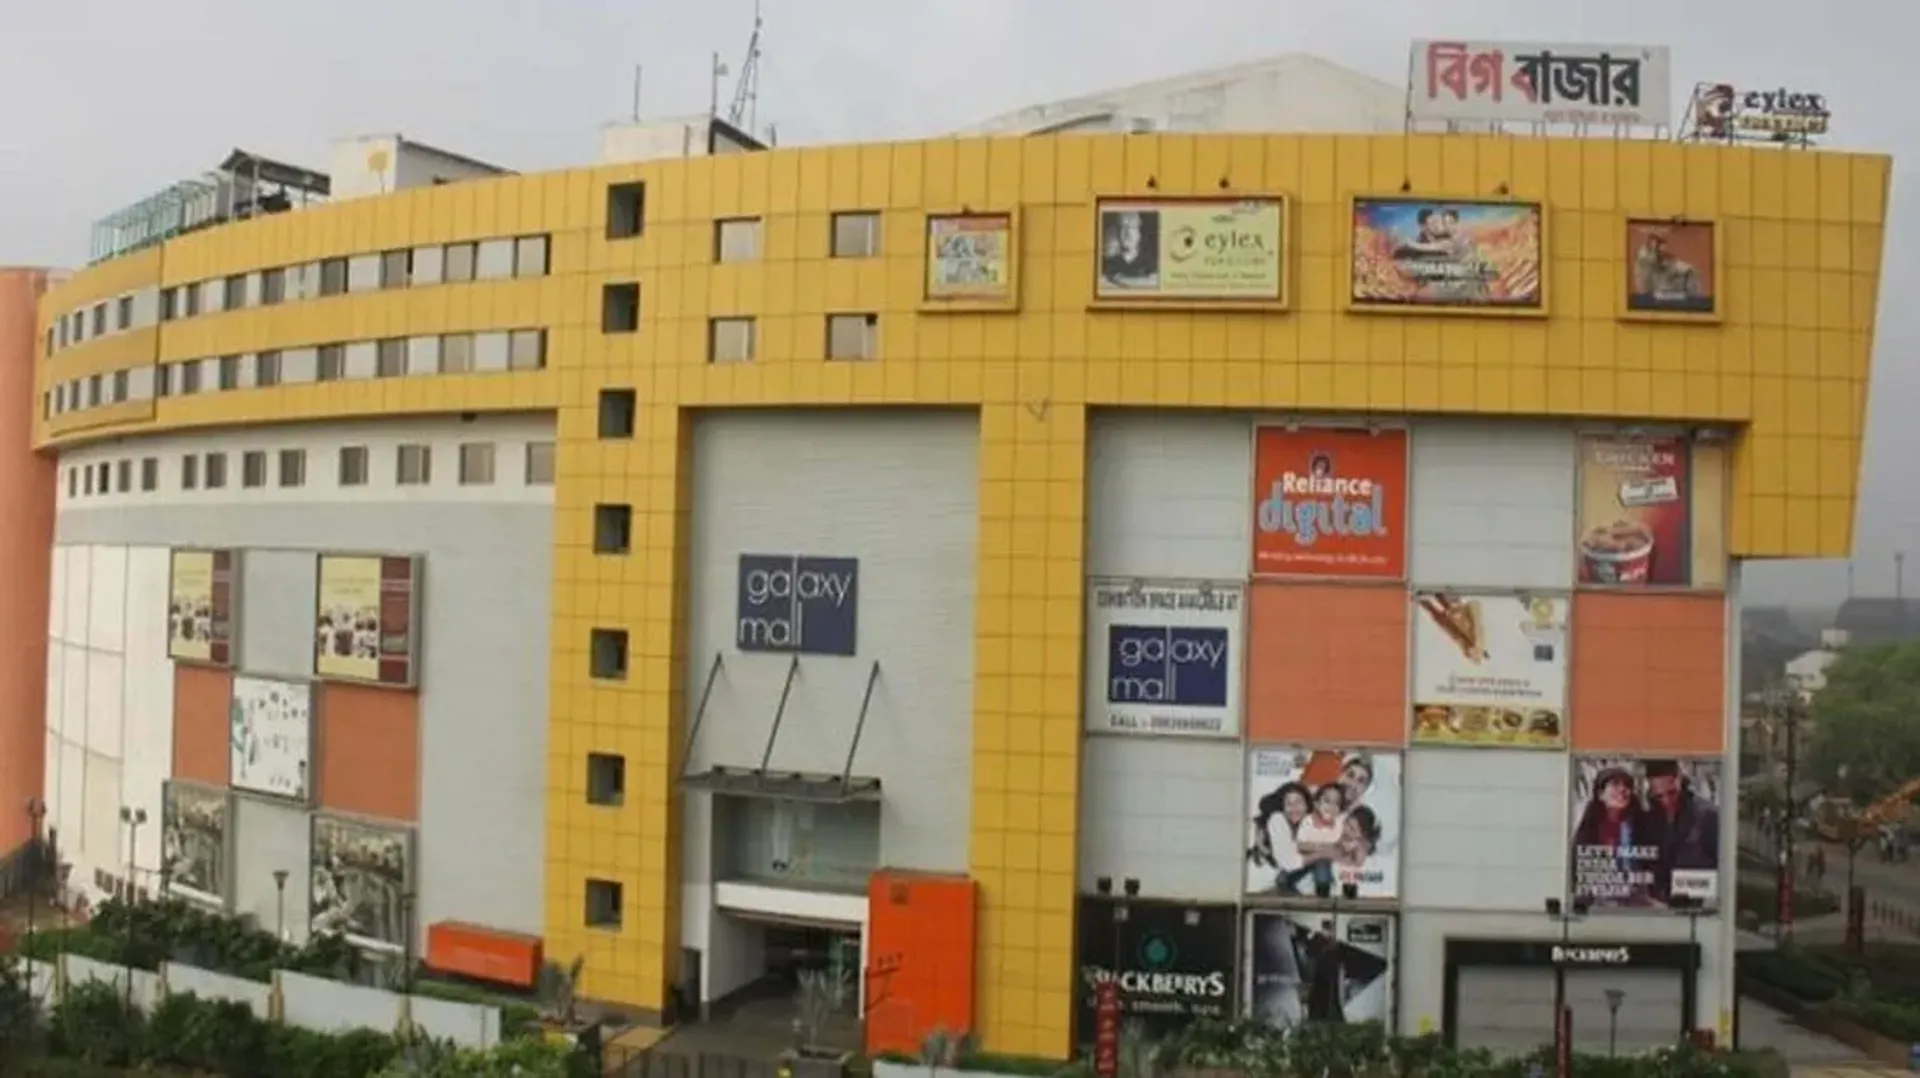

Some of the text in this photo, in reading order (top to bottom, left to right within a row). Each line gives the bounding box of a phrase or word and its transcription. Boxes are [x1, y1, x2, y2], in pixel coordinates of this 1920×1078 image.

[1428, 43, 1640, 107] বিগ বাজার
[1744, 87, 1826, 113] eylex
[1204, 229, 1264, 255] eylex
[1283, 470, 1373, 495] Reliance
[1258, 480, 1384, 545] digital
[747, 556, 853, 608] galaxy
[739, 601, 803, 645] mall
[1118, 625, 1225, 668] galaxy
[1111, 664, 1177, 700] mall
[1577, 845, 1659, 859] LET'S MAKE
